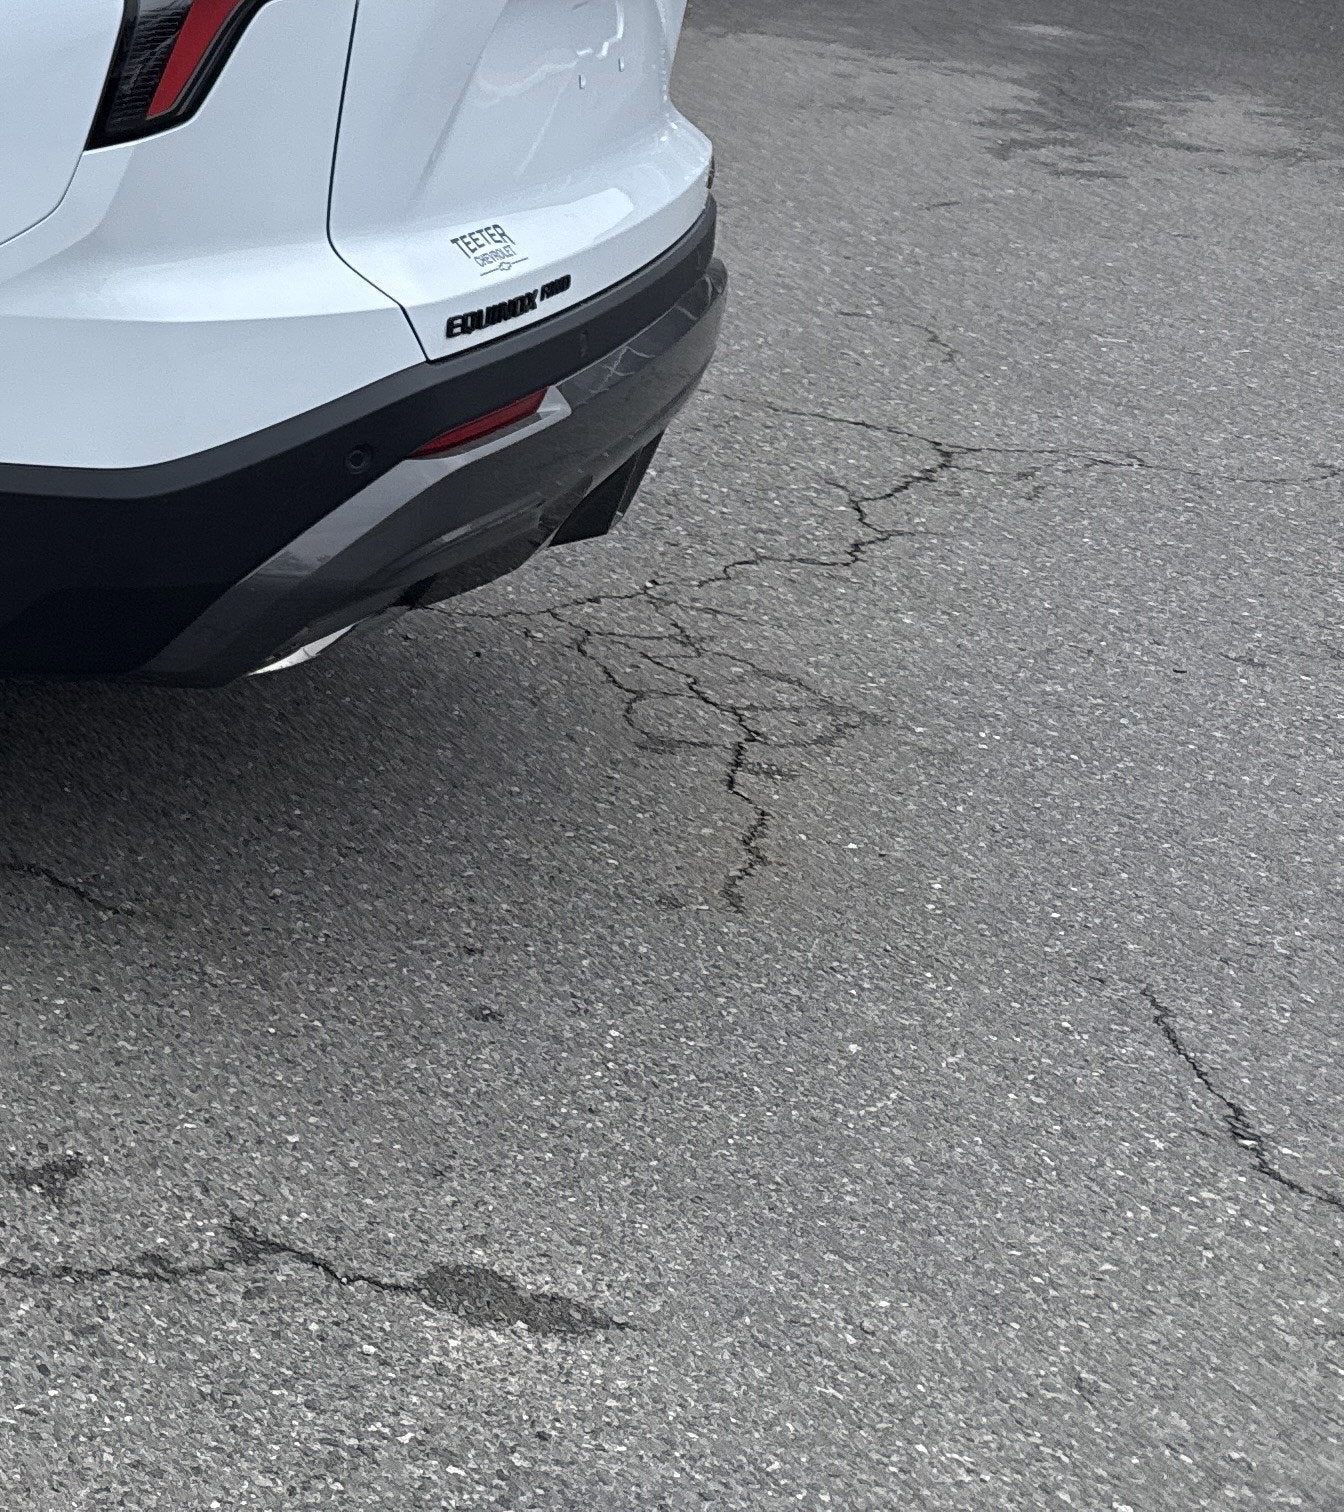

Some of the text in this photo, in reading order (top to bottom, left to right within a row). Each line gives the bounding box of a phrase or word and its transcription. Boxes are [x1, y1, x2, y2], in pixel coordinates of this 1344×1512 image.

[450, 223, 516, 259] TEETER
[474, 244, 517, 267] CHEVROLET
[445, 289, 538, 338] EQUINOX
